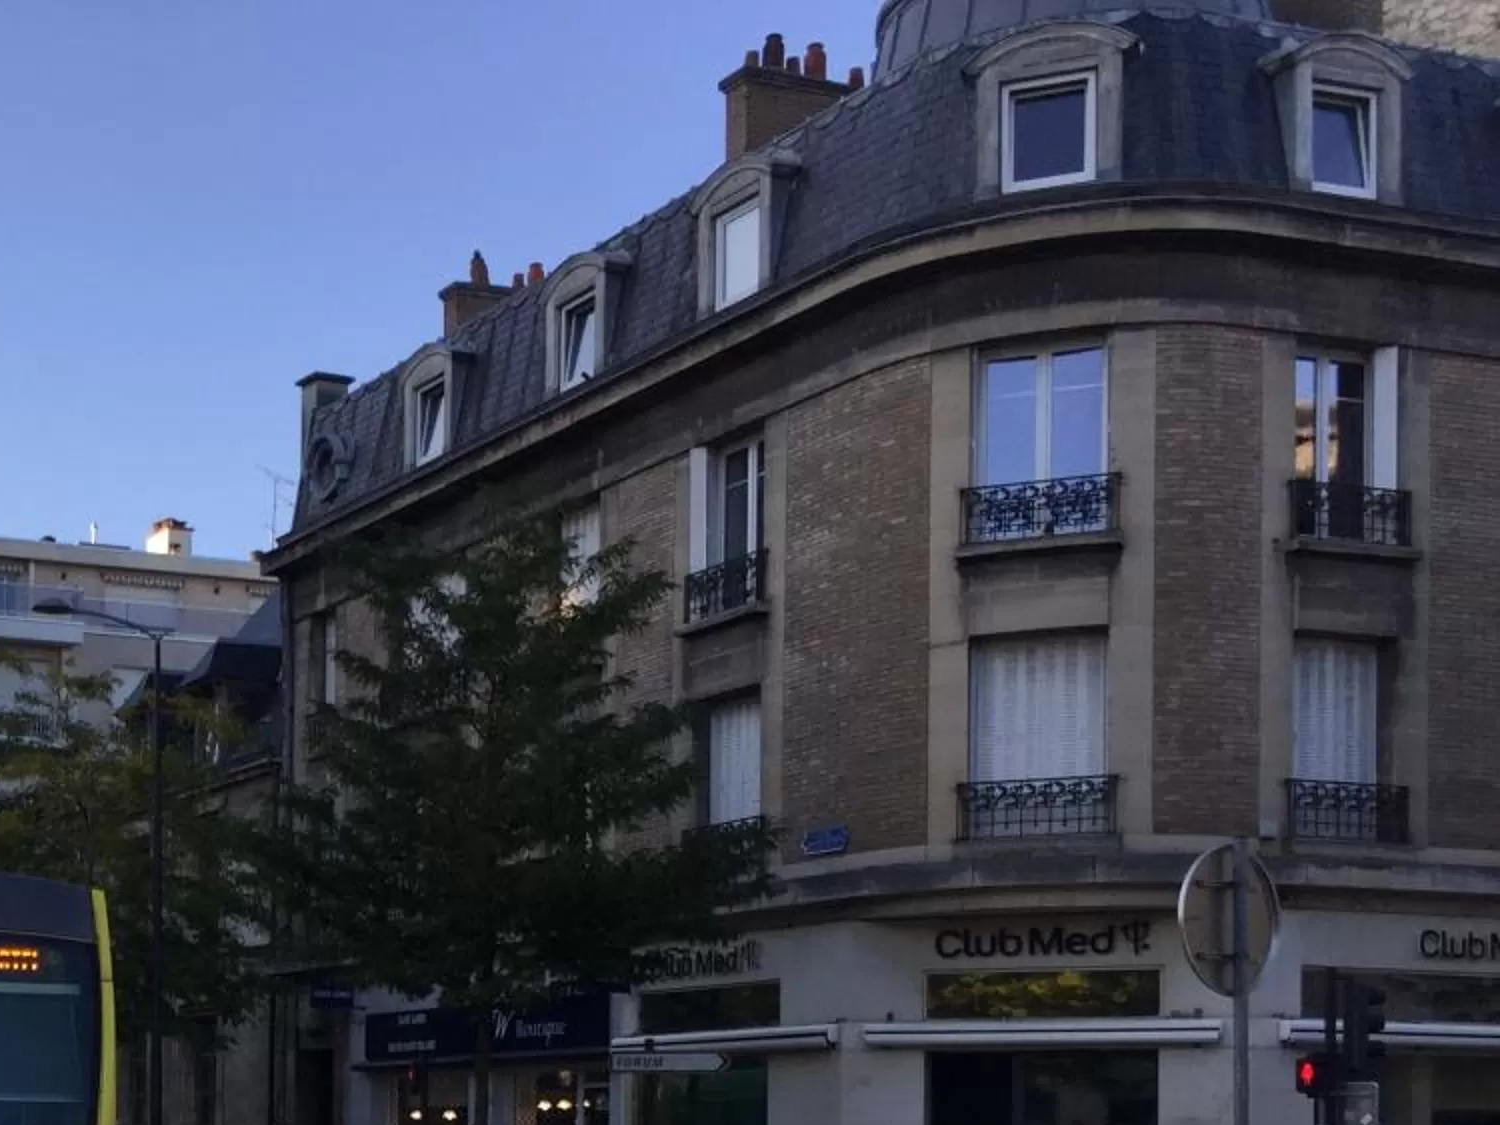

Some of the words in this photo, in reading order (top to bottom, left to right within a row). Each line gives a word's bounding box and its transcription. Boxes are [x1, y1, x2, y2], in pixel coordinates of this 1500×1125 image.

[934, 928, 1024, 960] Club
[1028, 925, 1114, 956] Med
[1419, 929, 1485, 960] Club
